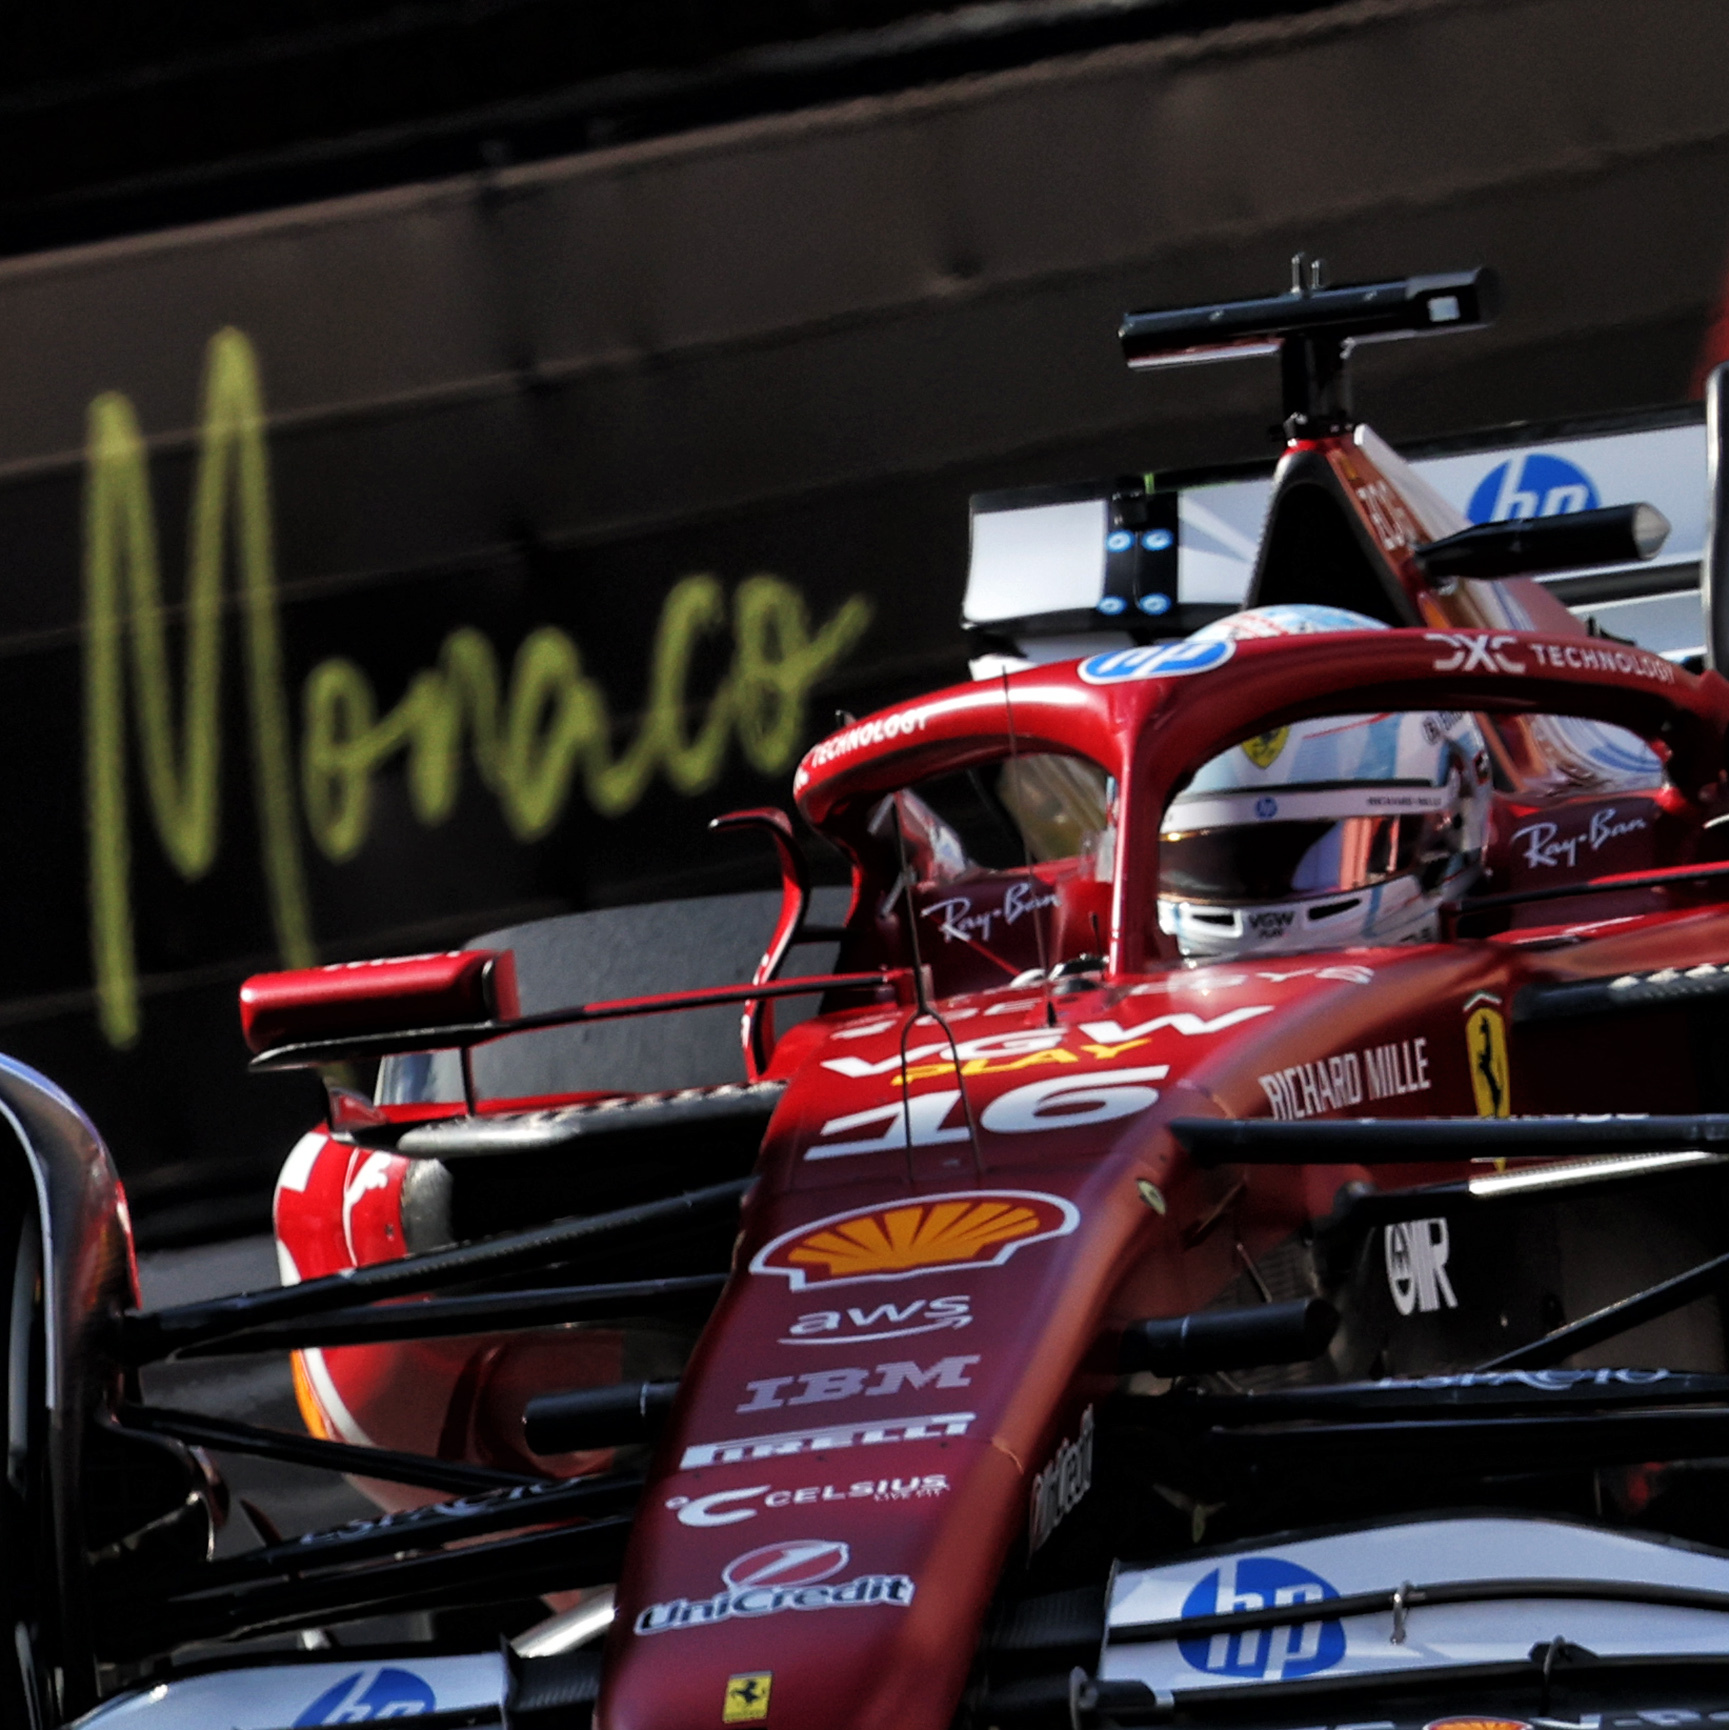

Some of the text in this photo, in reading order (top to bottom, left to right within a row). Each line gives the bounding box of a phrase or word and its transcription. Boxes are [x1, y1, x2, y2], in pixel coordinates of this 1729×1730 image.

[1090, 638, 1228, 680] hp
[1425, 633, 1676, 685] DXC TECHNOLOGY
[82, 326, 872, 1060] Monaco
[1512, 808, 1647, 868] Ray-Ban
[919, 882, 1062, 943] Ray-Ban
[821, 1004, 1276, 1078] VGW
[891, 1037, 1153, 1087] PLAY
[1258, 1036, 1432, 1121] RICHARD MILLE
[803, 1065, 1170, 1161] 16
[789, 1295, 971, 1336] aws
[735, 1354, 982, 1415] IBM
[679, 1412, 976, 1470] PIRELLI
[764, 1474, 949, 1507] CELSIUS
[634, 1574, 915, 1636] UniCredit
[1205, 1553, 1324, 1681] hp
